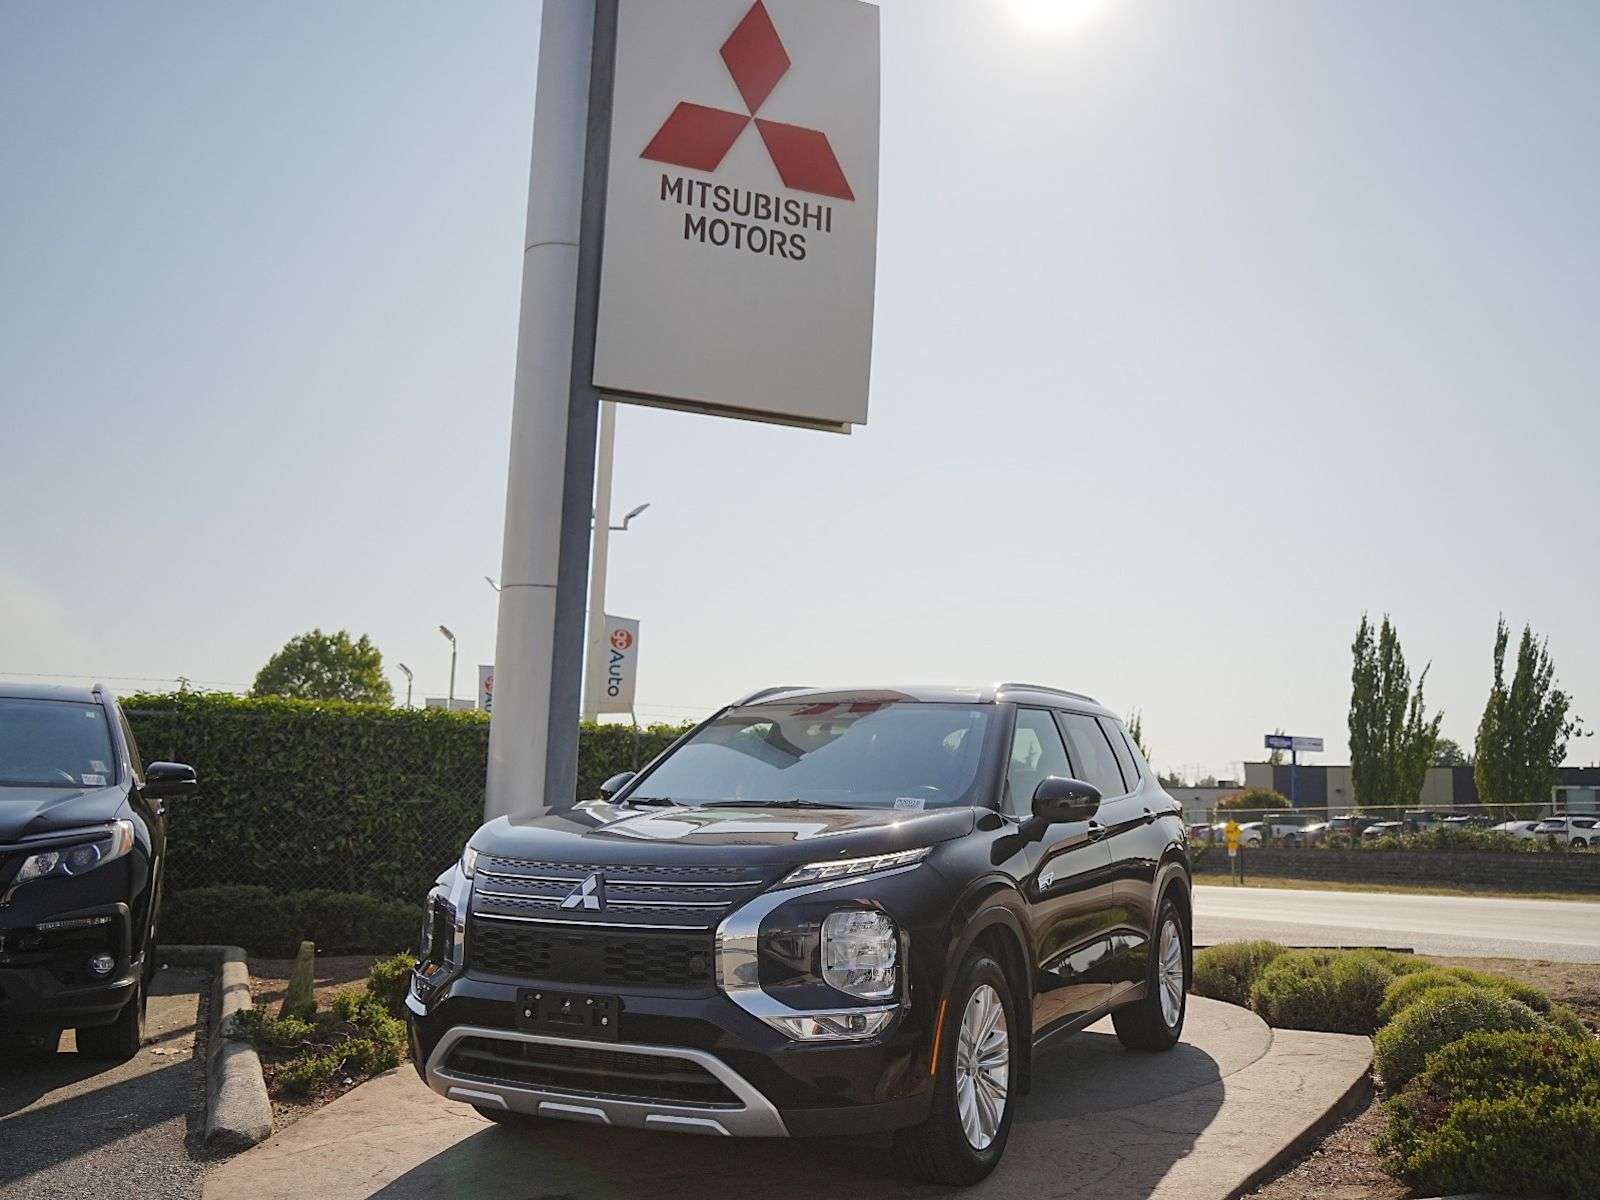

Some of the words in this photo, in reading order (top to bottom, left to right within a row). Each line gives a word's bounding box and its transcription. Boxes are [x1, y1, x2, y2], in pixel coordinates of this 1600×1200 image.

[660, 174, 832, 233] MITSUBISHI
[684, 213, 807, 261] MOTORS
[607, 649, 624, 697] Auto
